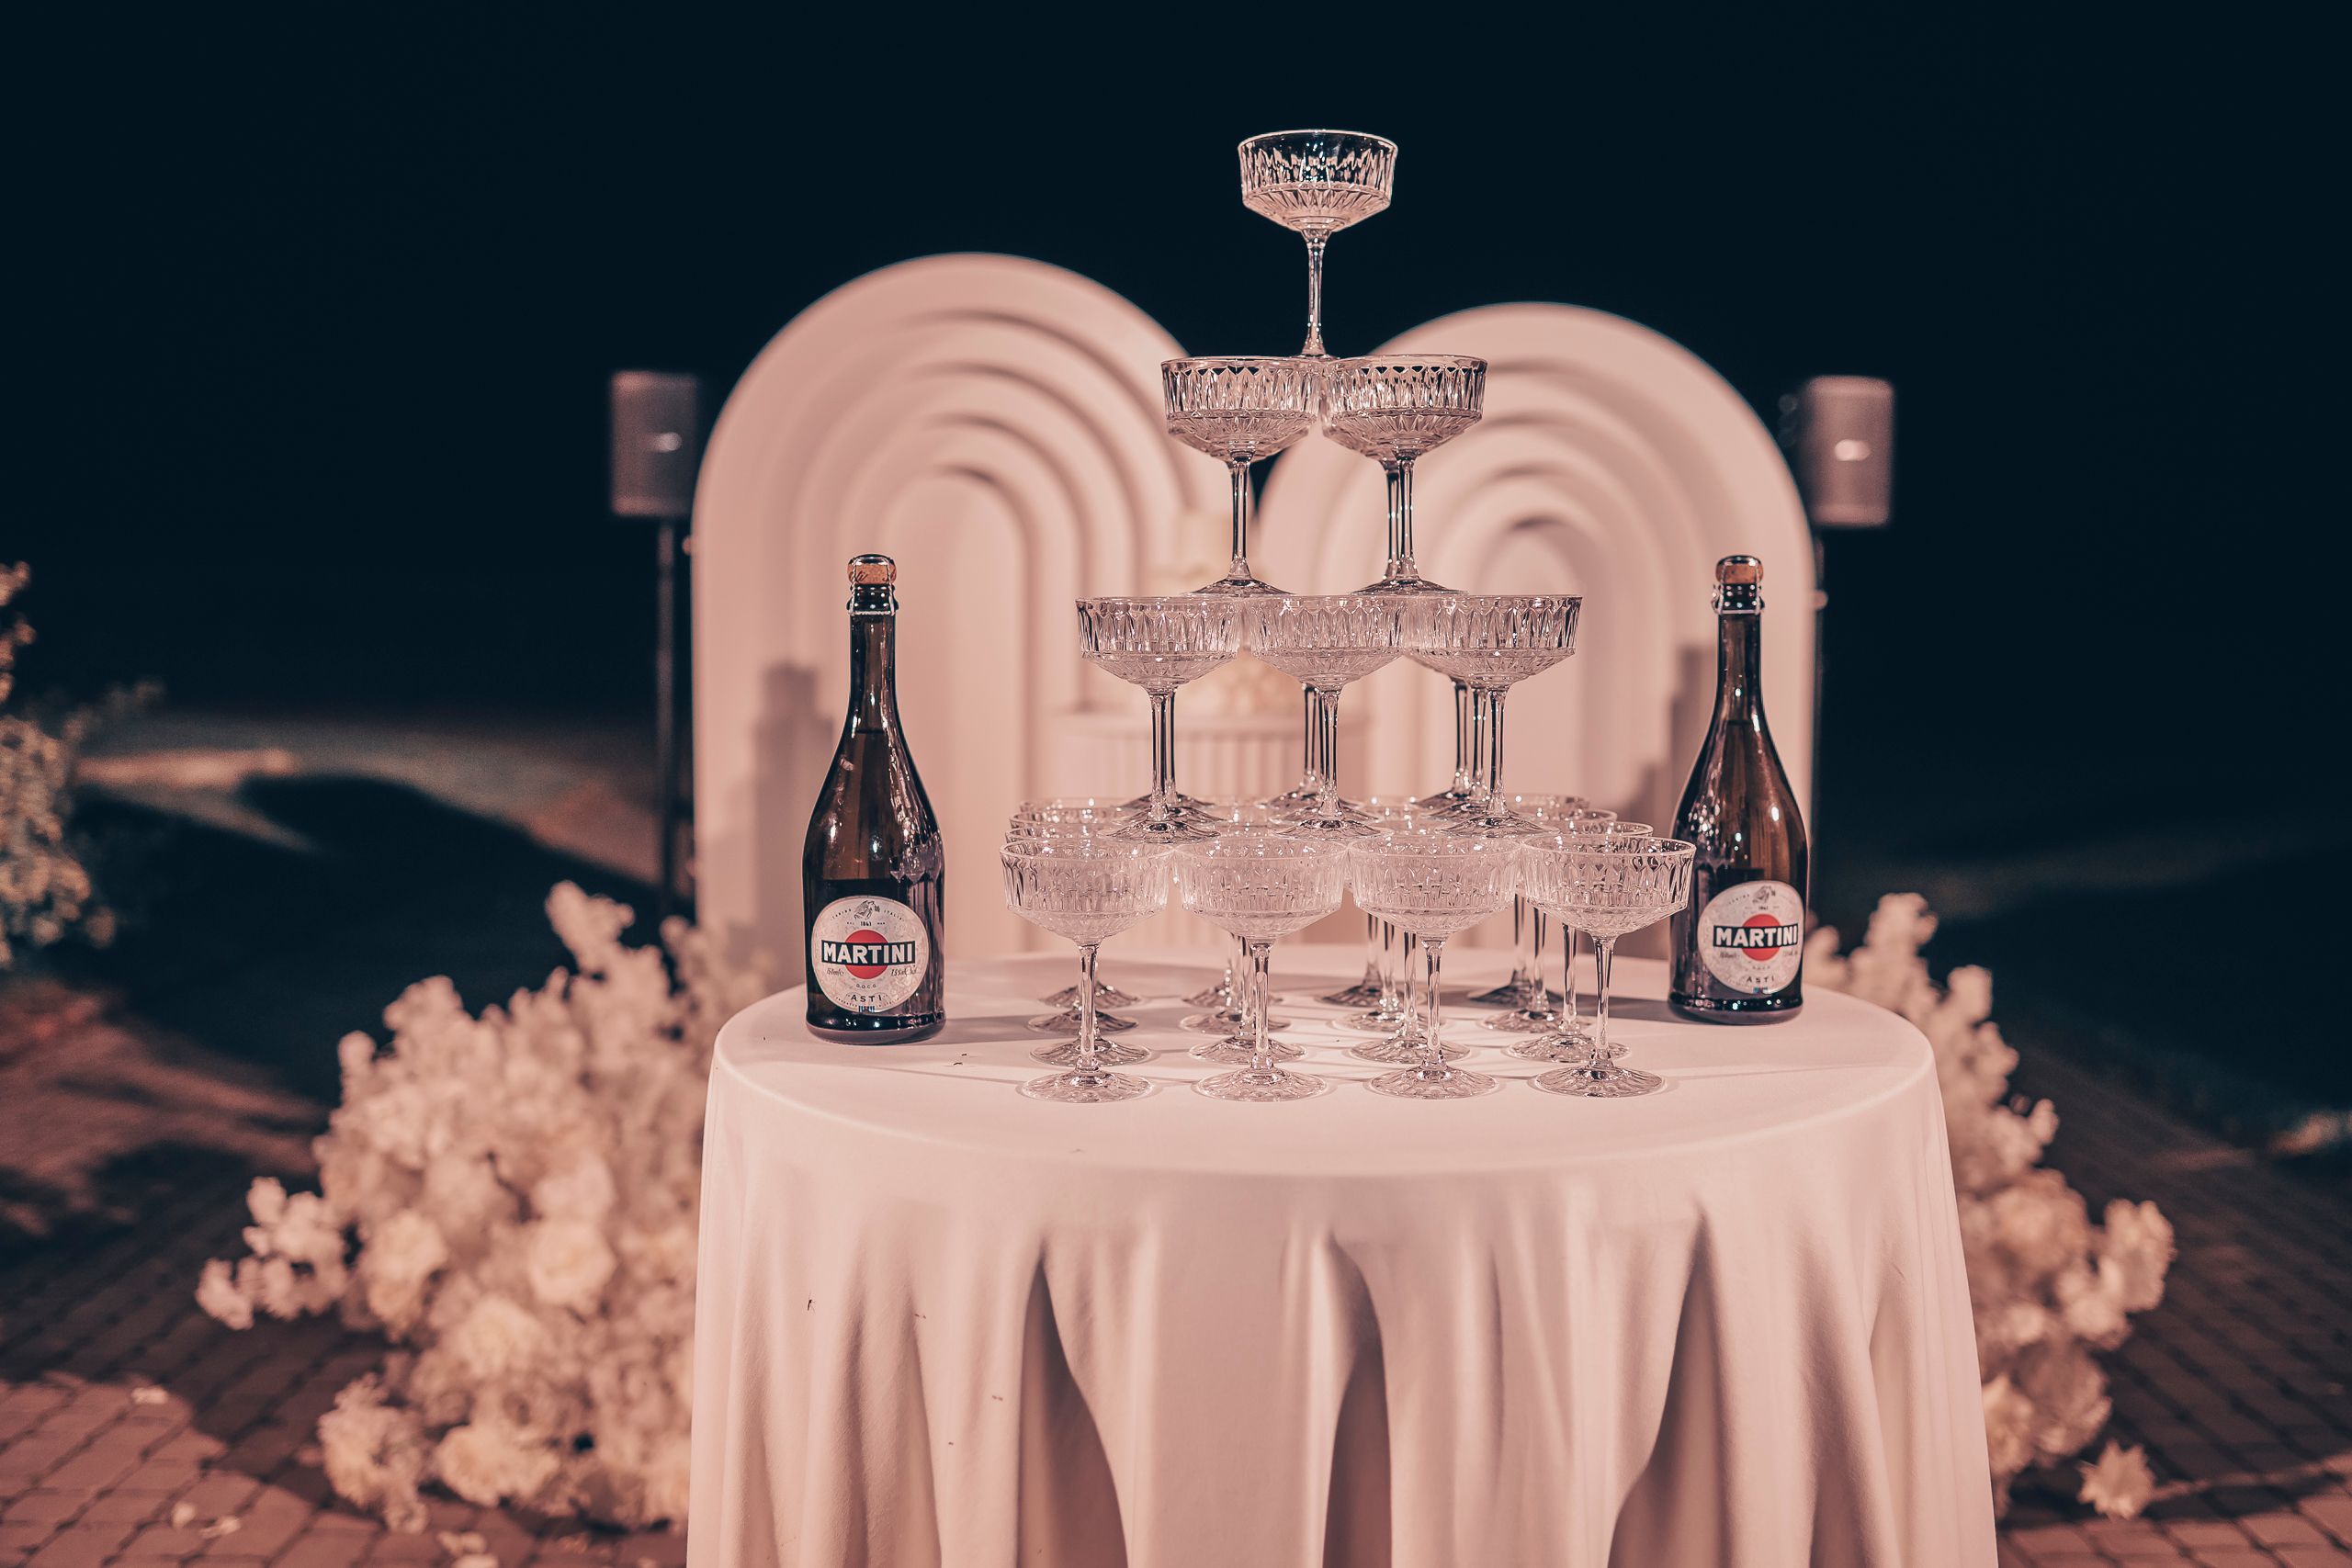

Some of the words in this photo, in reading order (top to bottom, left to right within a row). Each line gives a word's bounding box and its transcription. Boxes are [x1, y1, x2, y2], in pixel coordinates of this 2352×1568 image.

[1715, 926, 1797, 947] MARTINI
[823, 942, 912, 964] MARTINI
[1747, 976, 1774, 984] ASTI
[851, 994, 882, 1002] ASTI
